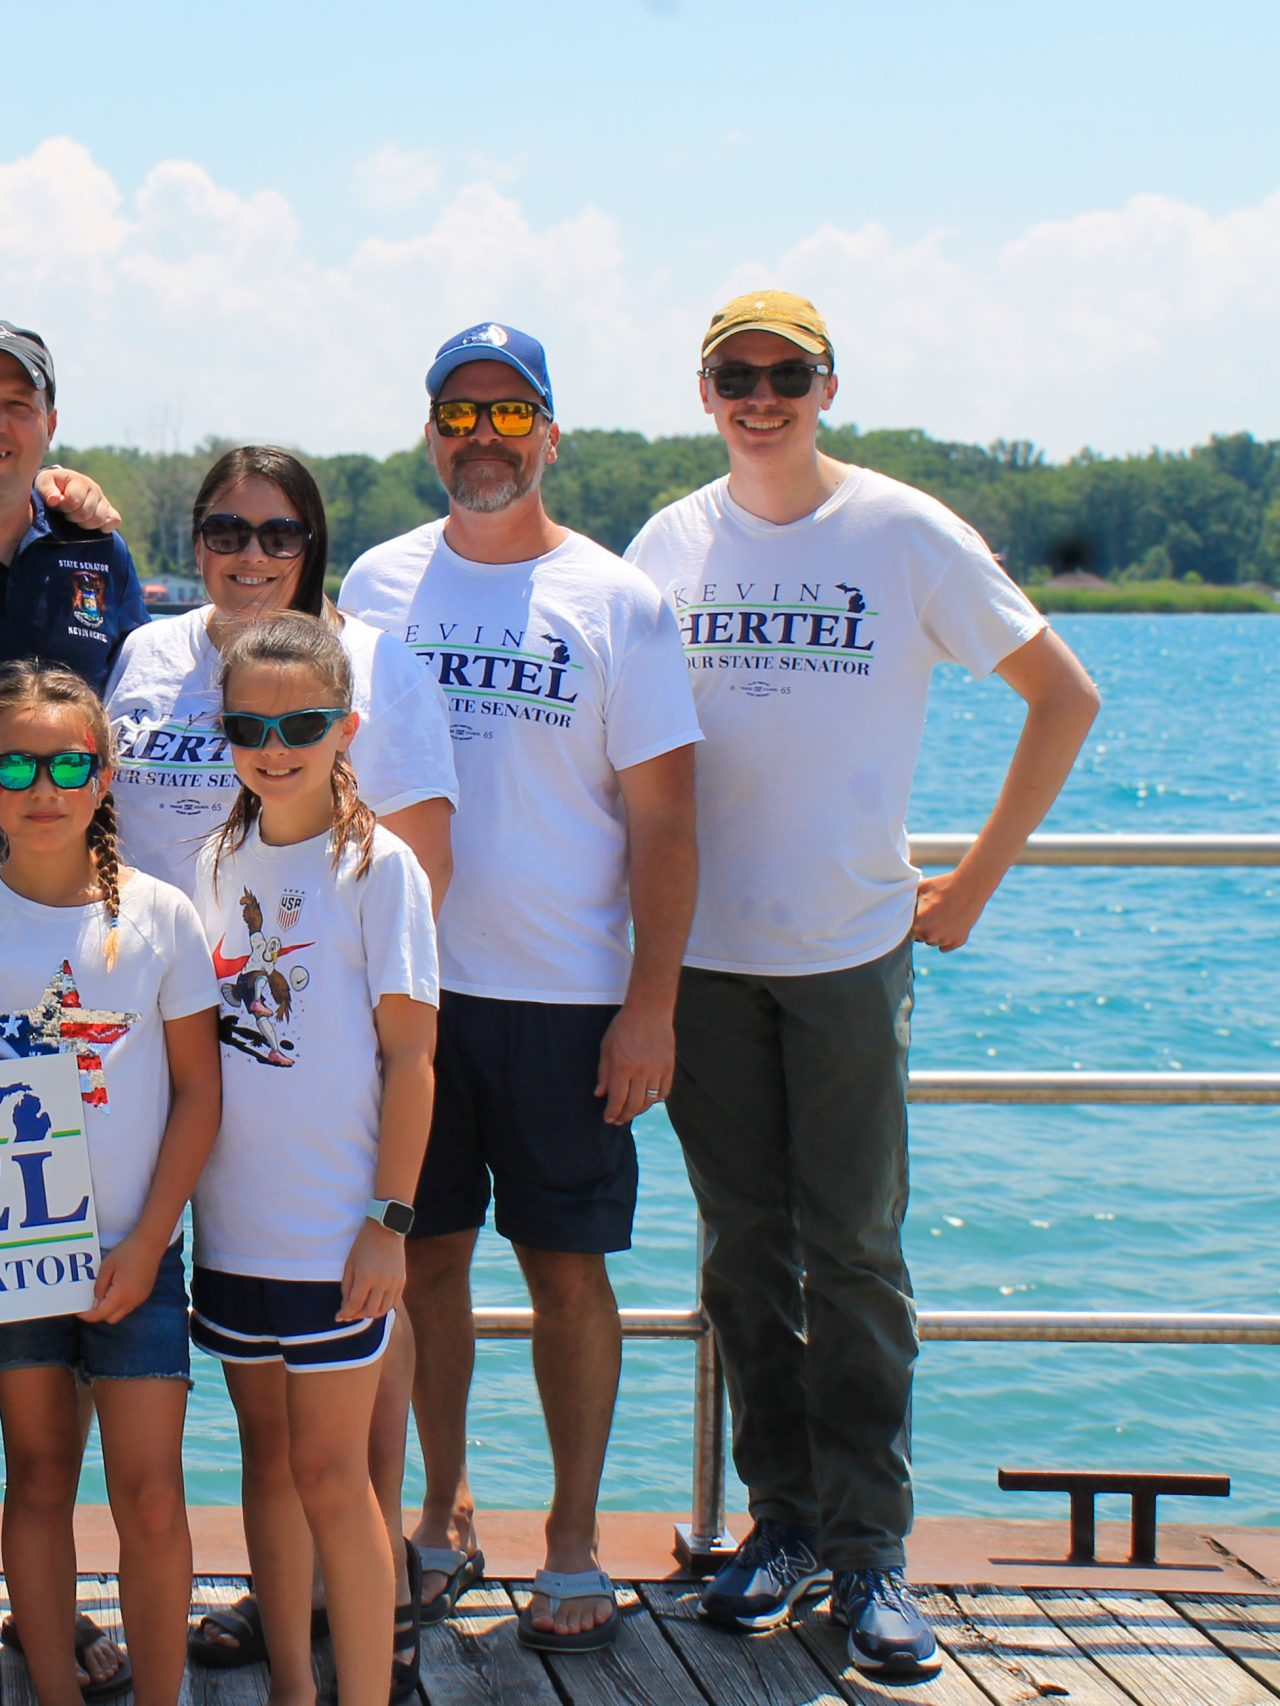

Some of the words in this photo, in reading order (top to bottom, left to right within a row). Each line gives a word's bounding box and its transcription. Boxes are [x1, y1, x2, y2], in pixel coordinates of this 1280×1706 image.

[59, 560, 78, 568] STATE
[80, 561, 109, 573] SENATOR
[673, 583, 821, 608] KEVIN
[68, 626, 88, 638] KEVIN
[405, 623, 525, 648] EVIN
[681, 611, 874, 651] HERTEL
[719, 655, 774, 670] STATE
[779, 656, 871, 677] SENATOR
[416, 652, 578, 704] RTEL
[781, 686, 791, 695] 65
[481, 701, 572, 728] SENATOR
[483, 731, 493, 739] 65
[146, 771, 203, 788] STATE
[211, 803, 221, 811] 65
[281, 896, 301, 911] USA
